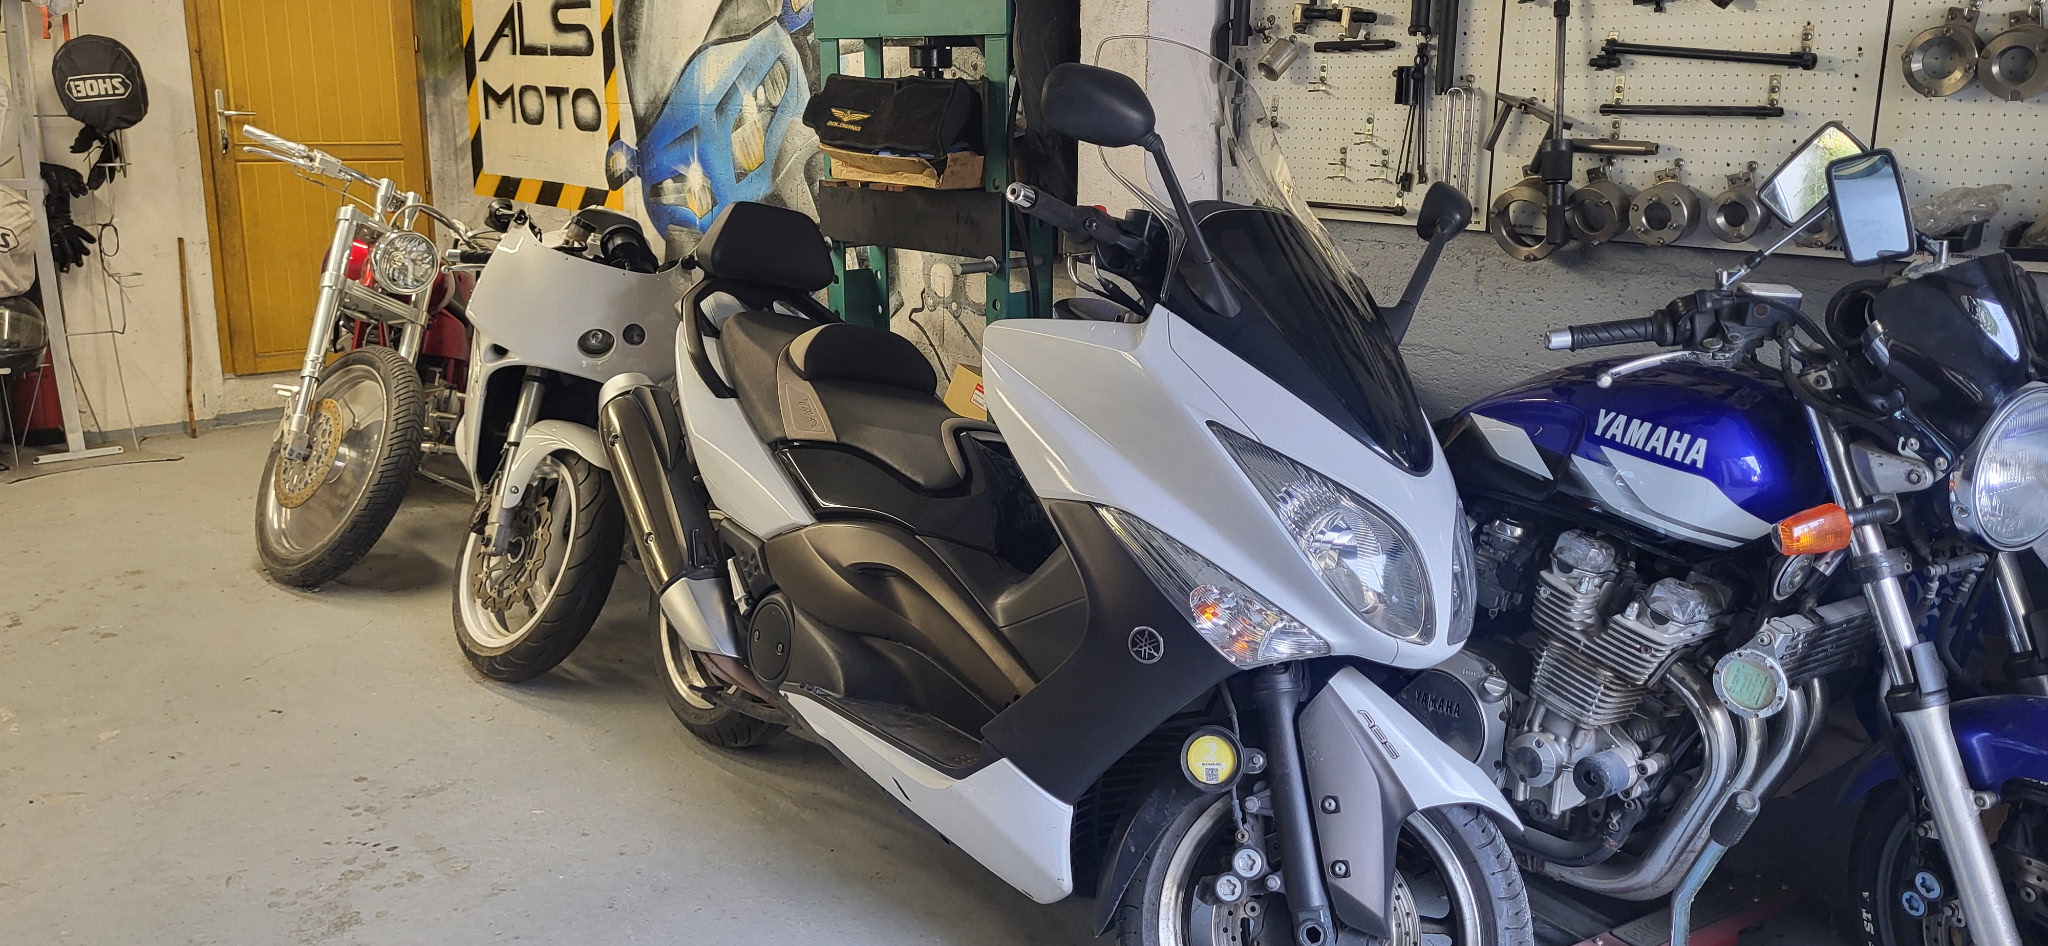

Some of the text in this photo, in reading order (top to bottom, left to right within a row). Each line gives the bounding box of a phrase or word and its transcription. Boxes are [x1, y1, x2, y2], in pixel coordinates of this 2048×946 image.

[478, 0, 595, 62] ALS
[70, 77, 125, 98] SHOEI
[482, 78, 602, 132] MOTO
[1594, 408, 1708, 469] YAMAHA
[1415, 689, 1460, 719] YAMAHA
[1203, 742, 1218, 761] 2
[1357, 709, 1400, 760] ABS
